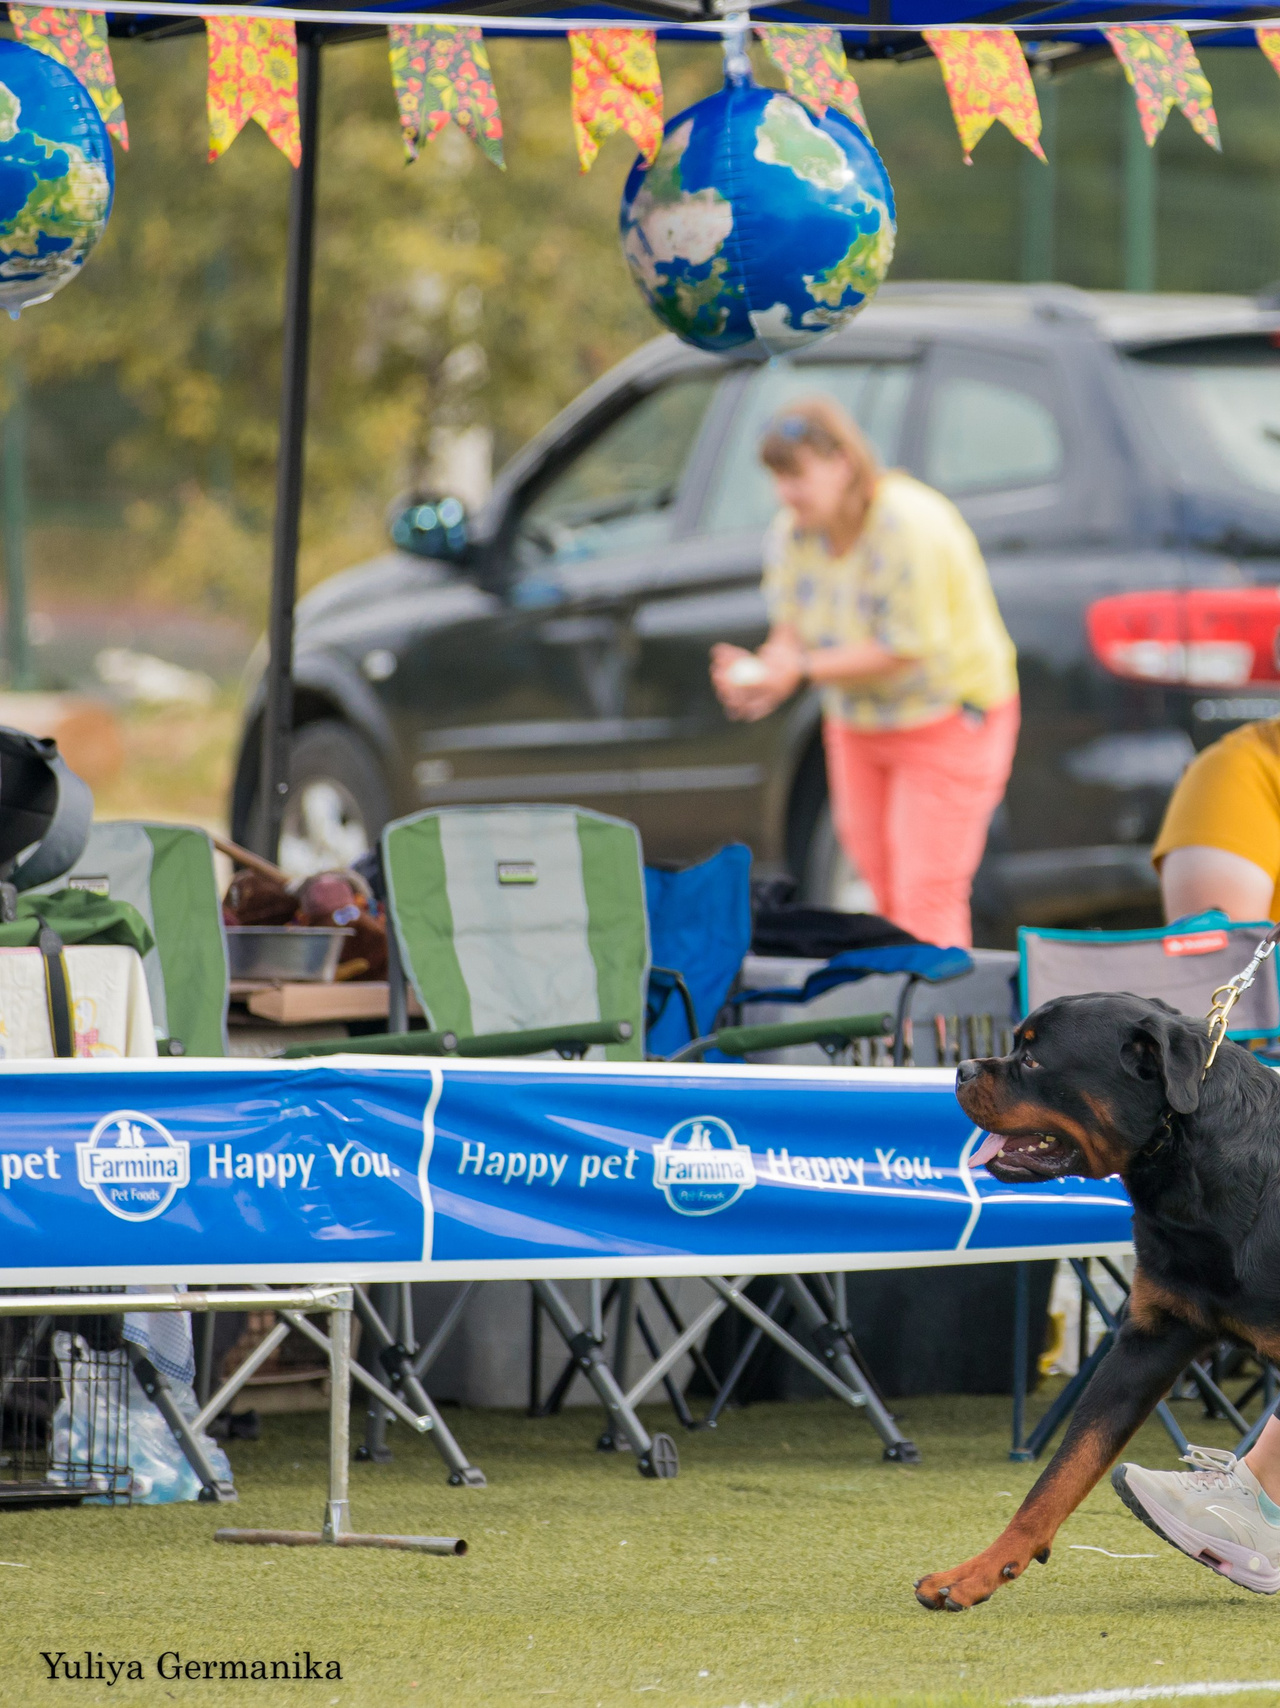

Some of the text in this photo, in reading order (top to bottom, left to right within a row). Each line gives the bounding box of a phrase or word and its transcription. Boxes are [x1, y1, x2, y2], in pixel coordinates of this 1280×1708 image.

[1, 1146, 62, 1190] pet
[89, 1152, 178, 1178] Farmina
[209, 1142, 401, 1188] Happy You.
[458, 1141, 639, 1188] Happy pet
[665, 1154, 745, 1180] Farmina
[767, 1147, 943, 1188] Happy You.
[111, 1187, 161, 1202] Pet Foods
